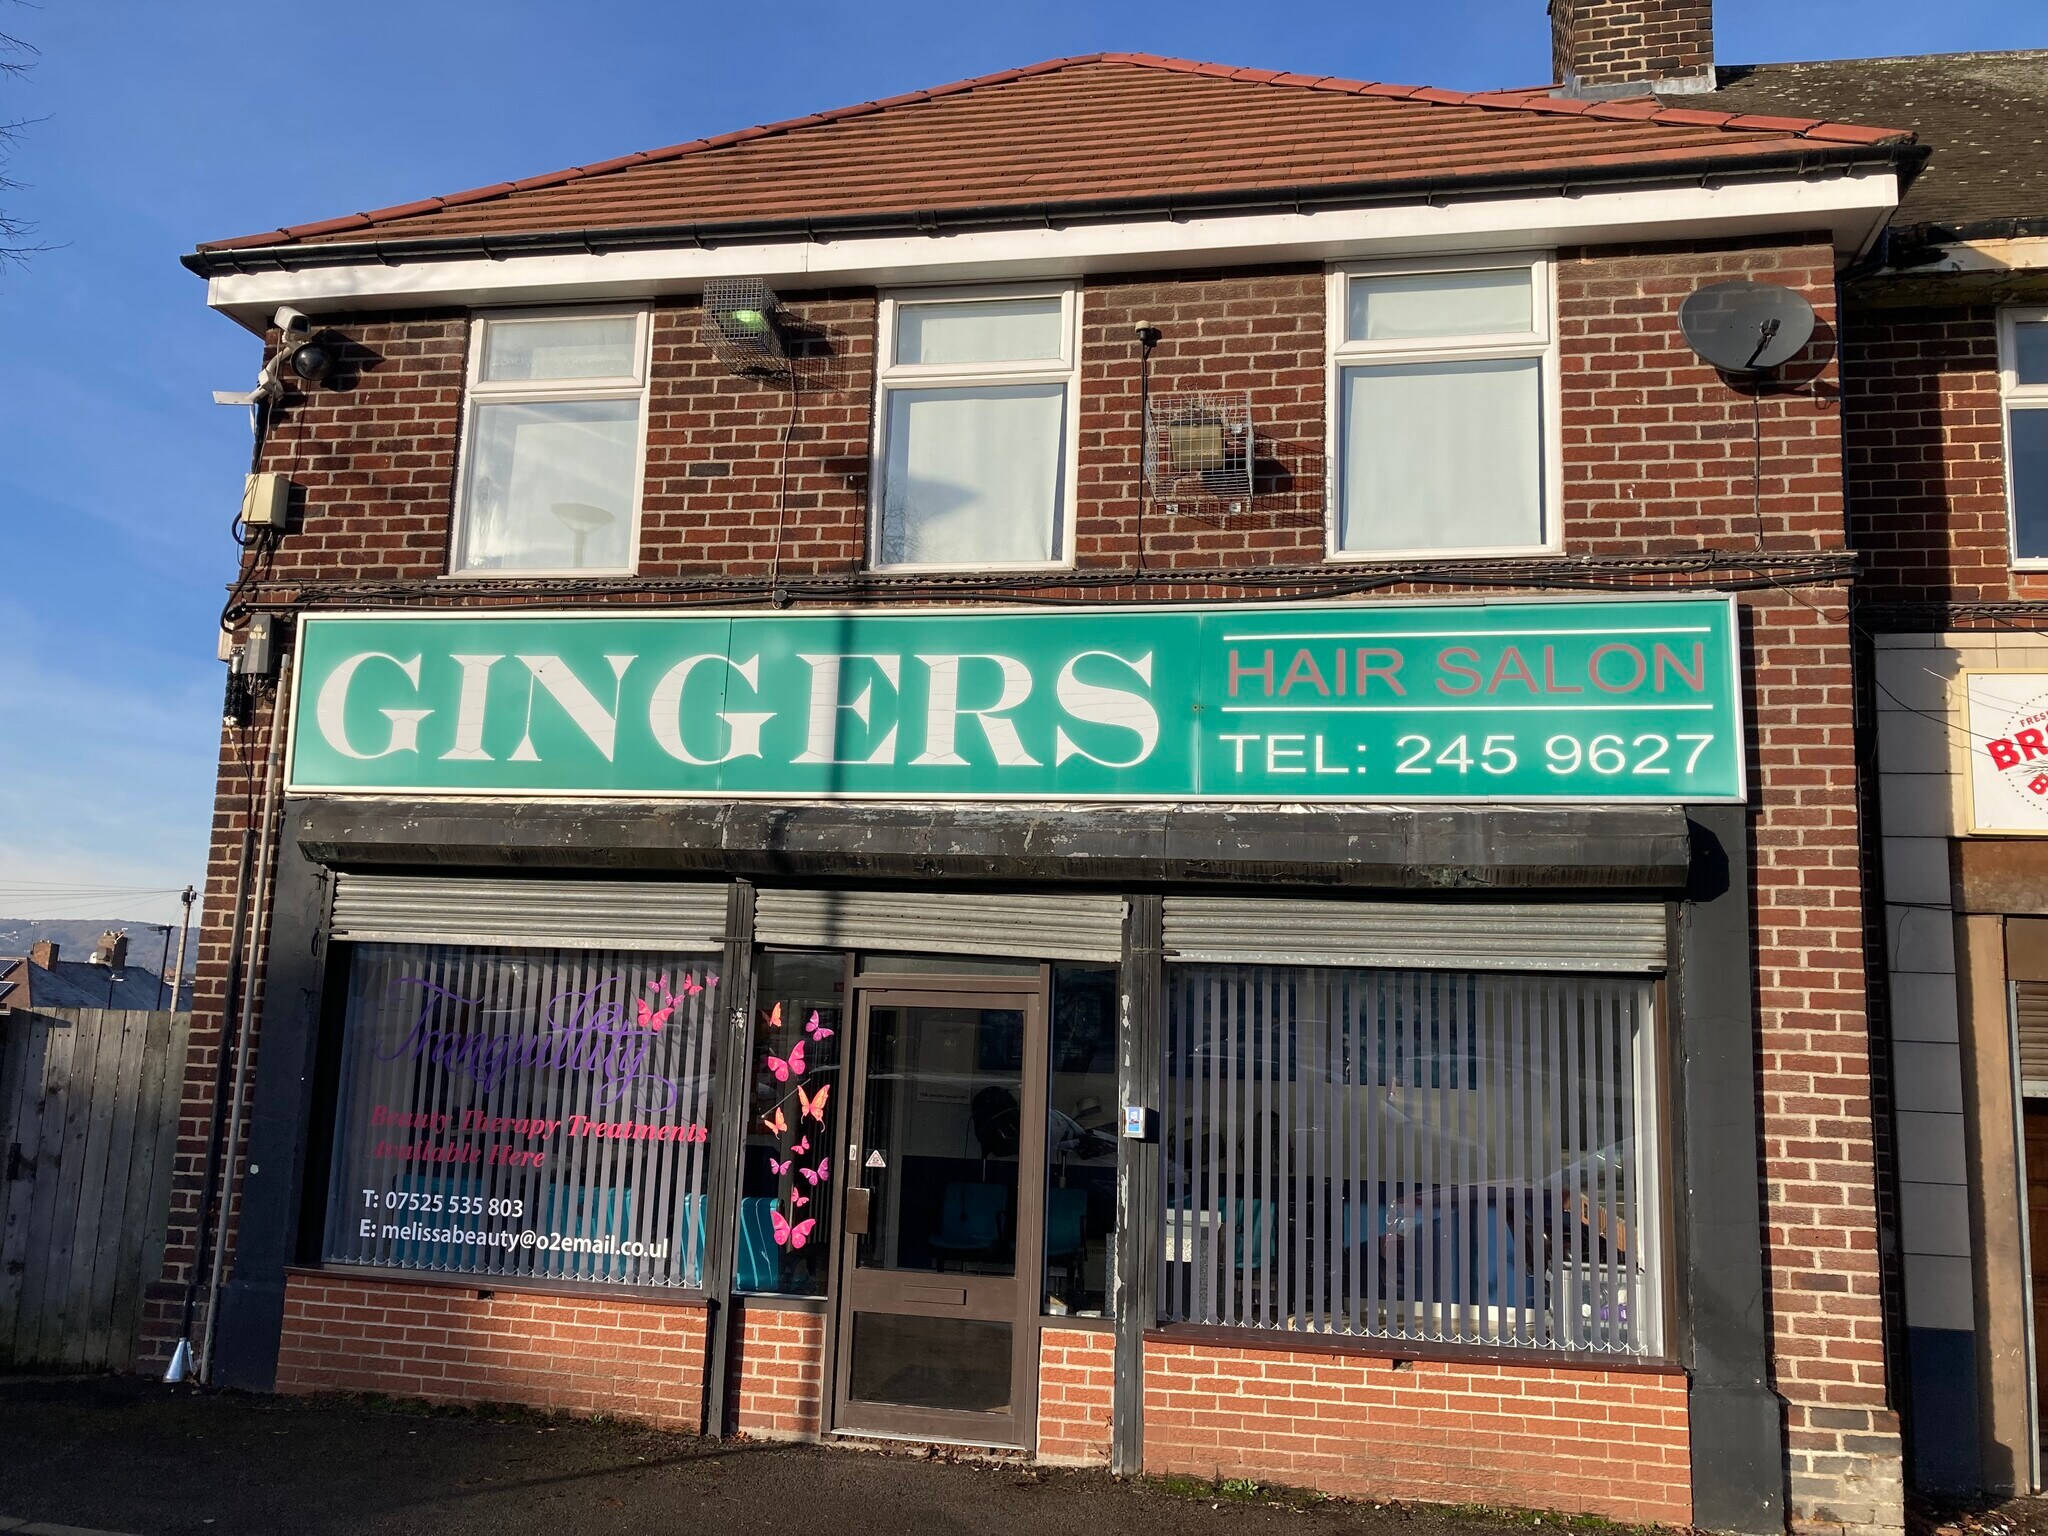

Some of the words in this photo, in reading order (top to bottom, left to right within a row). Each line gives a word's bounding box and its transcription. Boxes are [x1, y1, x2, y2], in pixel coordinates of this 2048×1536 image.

[1229, 648, 1407, 696] HAIR
[1435, 642, 1705, 695] SALON
[315, 650, 1161, 769] GINGERS
[1219, 734, 1368, 774] TEL:
[1395, 734, 1518, 774] 245
[1545, 733, 1715, 774] 9627
[371, 1105, 453, 1134] Beauty
[461, 1110, 561, 1140] Therapy
[568, 1115, 708, 1143] Treatments
[374, 1140, 481, 1164] Available
[488, 1144, 546, 1168] Here
[363, 1190, 379, 1209] T:
[385, 1191, 443, 1213] 07525
[448, 1196, 483, 1215] 535
[488, 1198, 523, 1218] 803
[359, 1219, 376, 1238] E:
